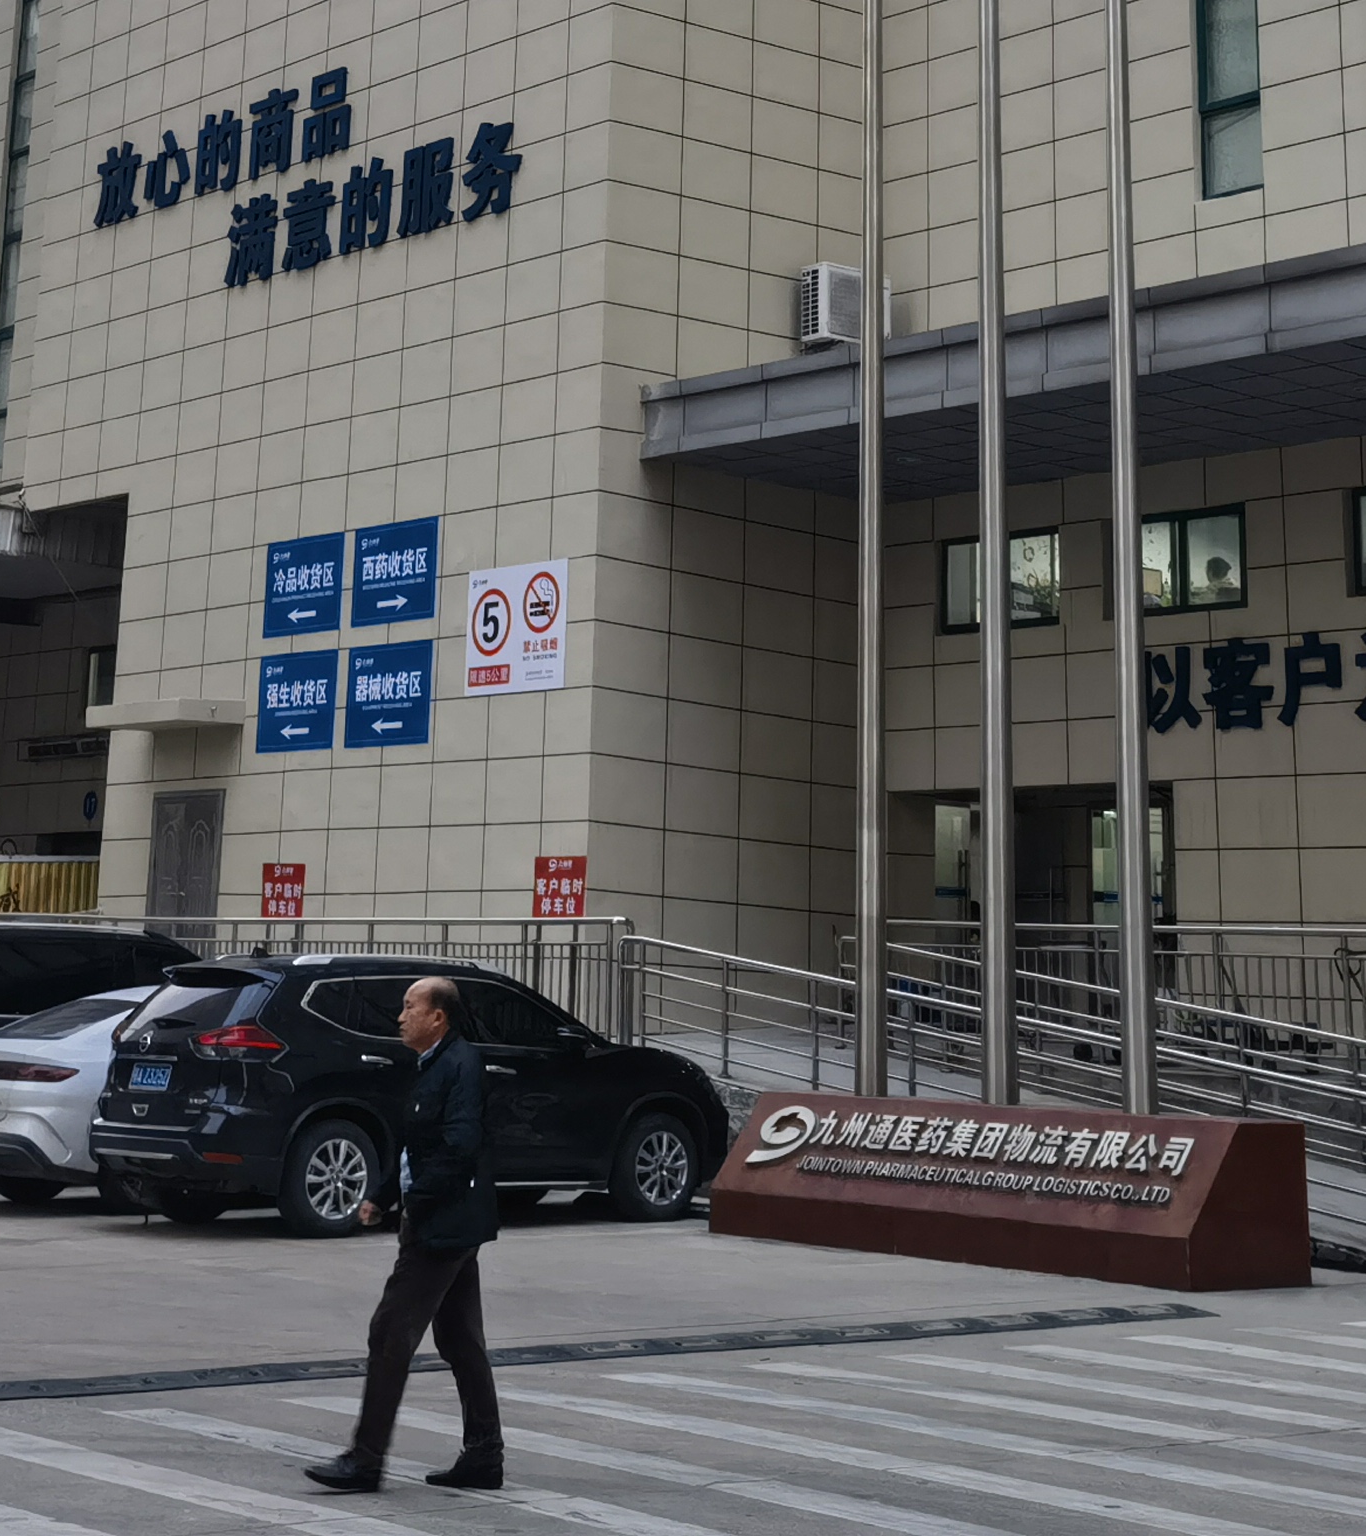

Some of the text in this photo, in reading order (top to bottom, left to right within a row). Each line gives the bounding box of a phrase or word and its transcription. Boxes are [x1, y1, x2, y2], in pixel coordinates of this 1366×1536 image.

[93, 67, 352, 228] 放心的商品
[224, 122, 522, 287] 满意的服务
[273, 562, 335, 594] 冷品收货区
[362, 547, 428, 582] 西药收货区
[482, 600, 499, 643] 5
[522, 637, 558, 653] 禁止吸烟
[355, 671, 422, 702] 器械收货区
[469, 667, 509, 684] 限速5公里
[267, 679, 328, 709] 强生收货区
[264, 882, 302, 899] 客户临时
[537, 878, 583, 895] 客户临时
[268, 899, 295, 916] 停车位
[541, 897, 575, 915] 停车位
[810, 1110, 1195, 1176] 九州通医药集团物流有限公司
[796, 1155, 864, 1175] JOINTOWN
